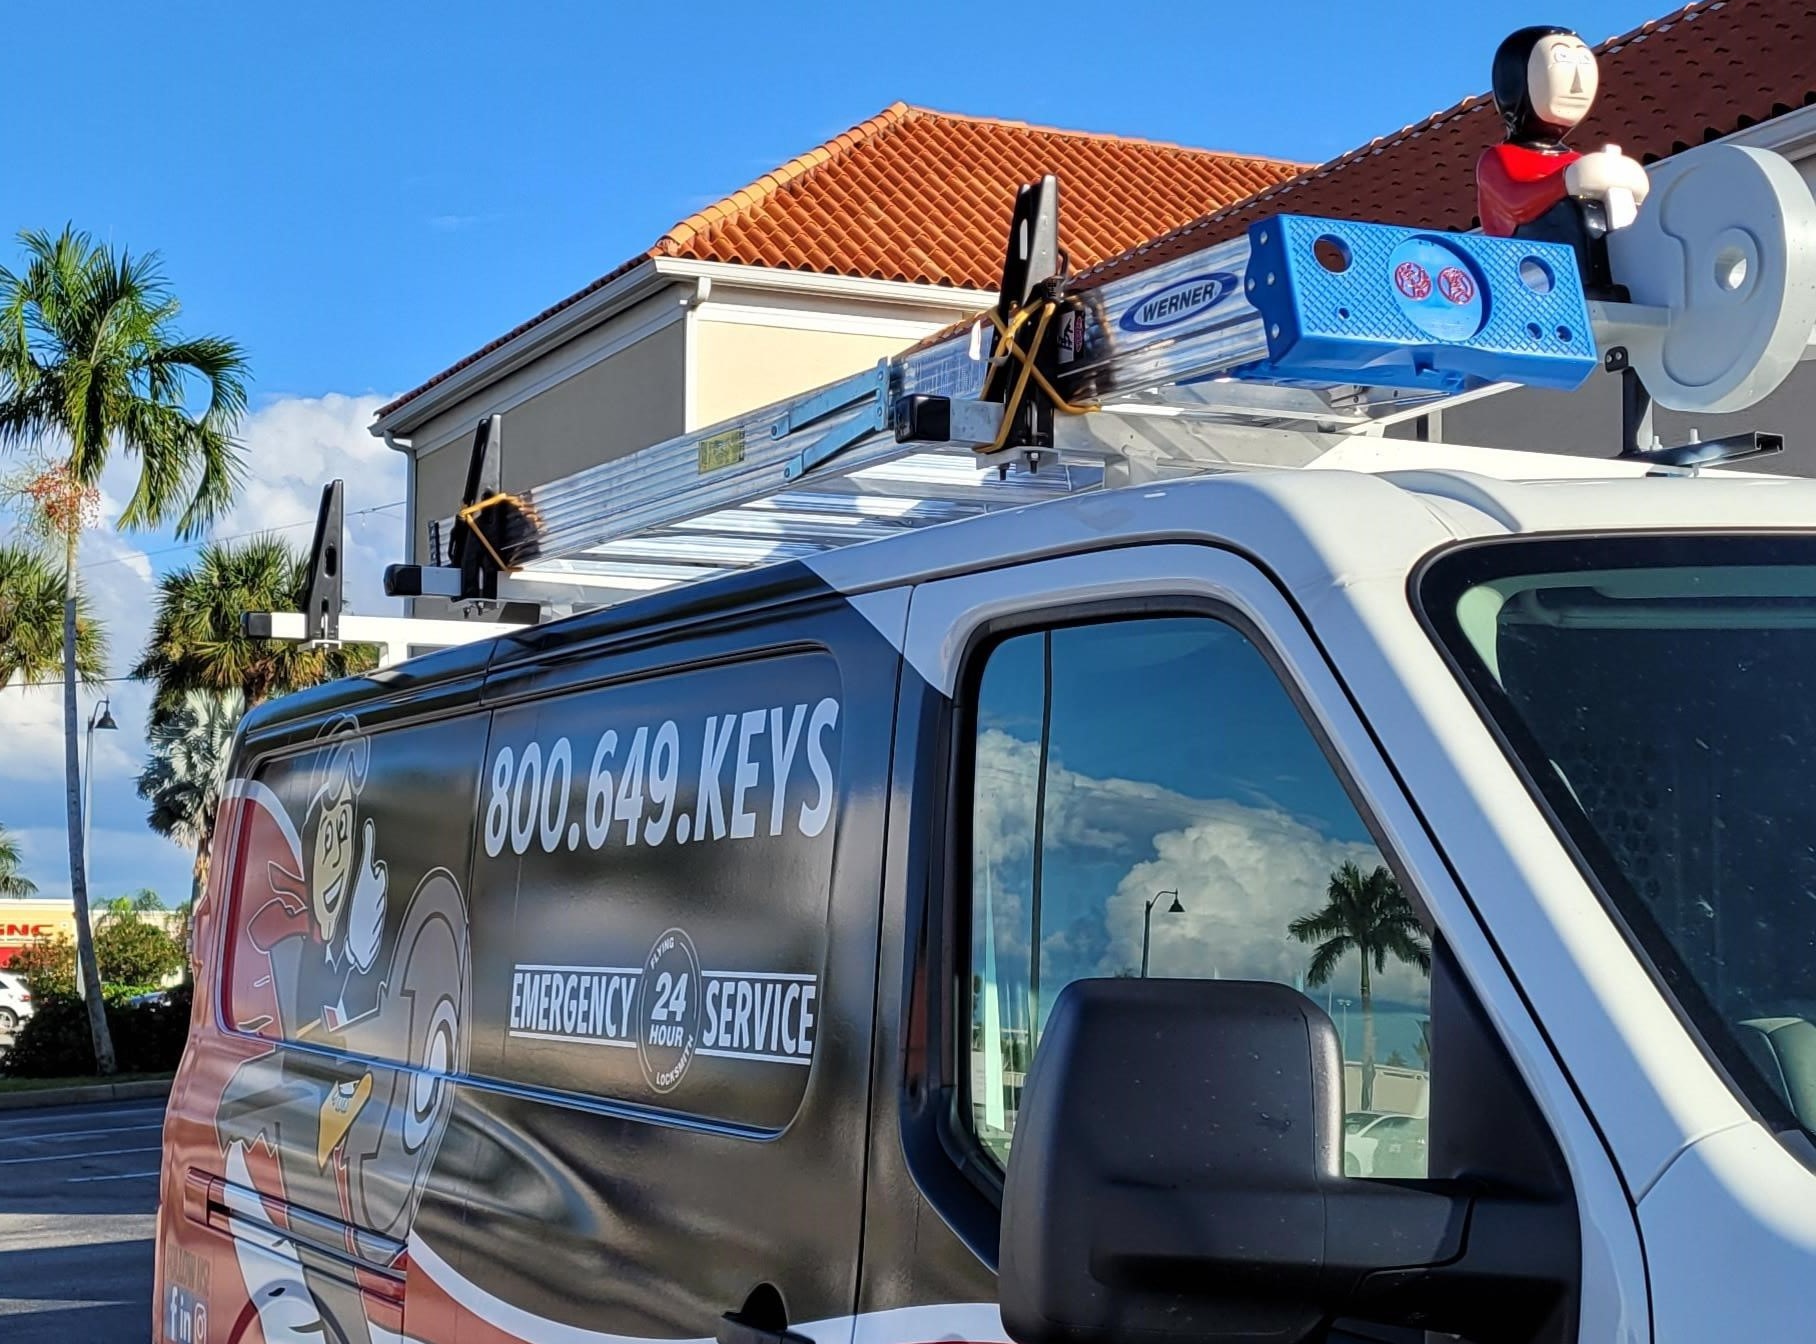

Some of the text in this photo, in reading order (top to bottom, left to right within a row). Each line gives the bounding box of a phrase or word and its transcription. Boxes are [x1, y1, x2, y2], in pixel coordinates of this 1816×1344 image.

[1142, 281, 1215, 323] WERNER
[484, 697, 840, 858] 800.649.KEYS
[0, 923, 54, 937] NC
[650, 937, 675, 970] FLYING
[510, 972, 637, 1038] EMERGENCY
[651, 972, 689, 1022] 24
[702, 979, 817, 1055] SERVICE
[649, 1023, 685, 1048] HOUR
[656, 1034, 694, 1086] LOCKSMITH
